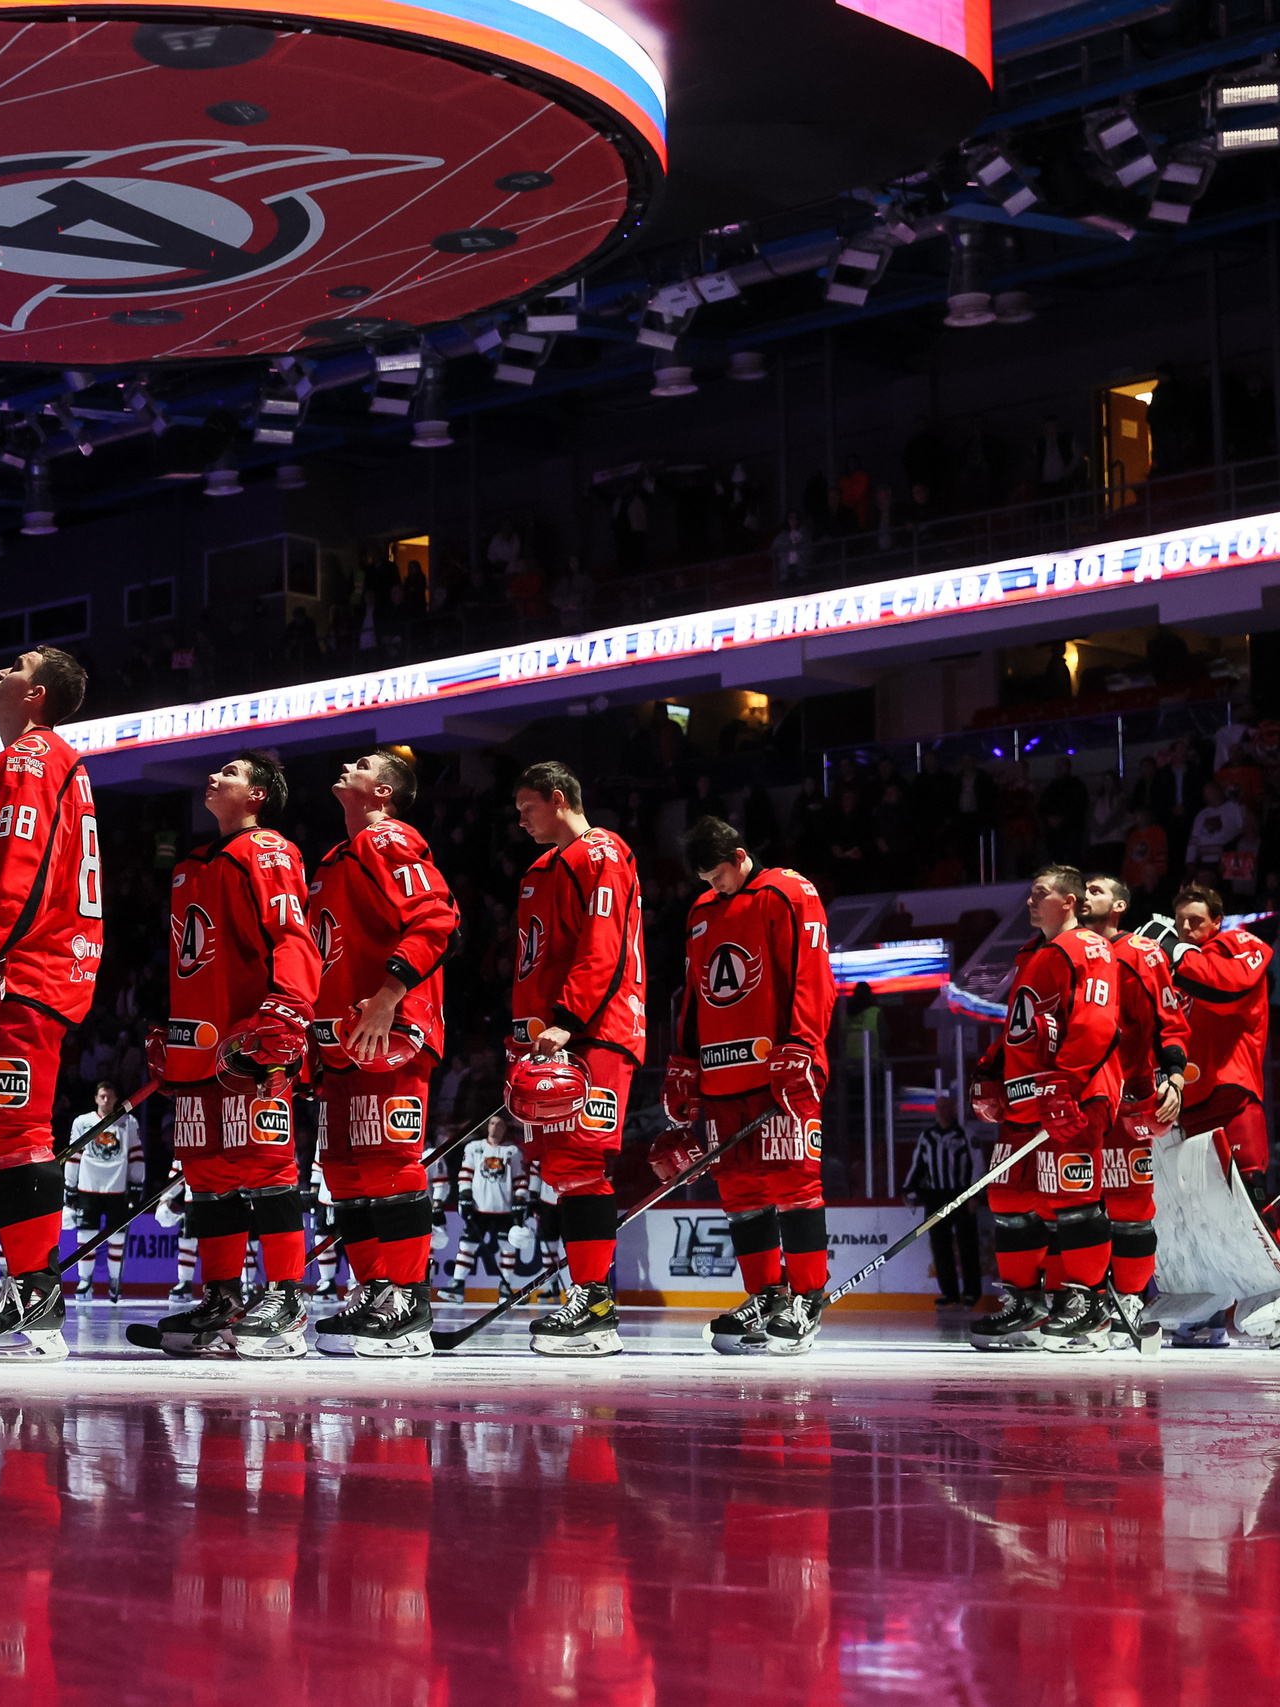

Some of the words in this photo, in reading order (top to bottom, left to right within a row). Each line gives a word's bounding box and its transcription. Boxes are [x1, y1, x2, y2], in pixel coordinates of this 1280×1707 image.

[498, 633, 628, 682] МОГУЧАЯ
[635, 618, 723, 657] ВОЛЯ,
[732, 594, 882, 642] ВЕЛИКАЯ
[891, 573, 1005, 618] СЛАВА
[137, 701, 251, 742] ЛЮБИМАЯ
[258, 689, 328, 723] НАША
[334, 671, 438, 711] СТРАНА.
[78, 813, 102, 919] 8
[393, 863, 431, 897] 71
[269, 893, 305, 927] 79
[588, 886, 613, 918] 10
[1085, 977, 1109, 1007] 18
[1161, 986, 1179, 1010] 4
[259, 1000, 310, 1029] CCM
[701, 1047, 748, 1066] Winline
[260, 1113, 288, 1130] Win
[394, 1112, 421, 1128] Win
[589, 1102, 616, 1119] Win
[761, 1115, 803, 1139] SIMA
[761, 1138, 804, 1161] LAND
[1067, 1165, 1092, 1179] Win
[830, 1255, 887, 1304] BAUER
